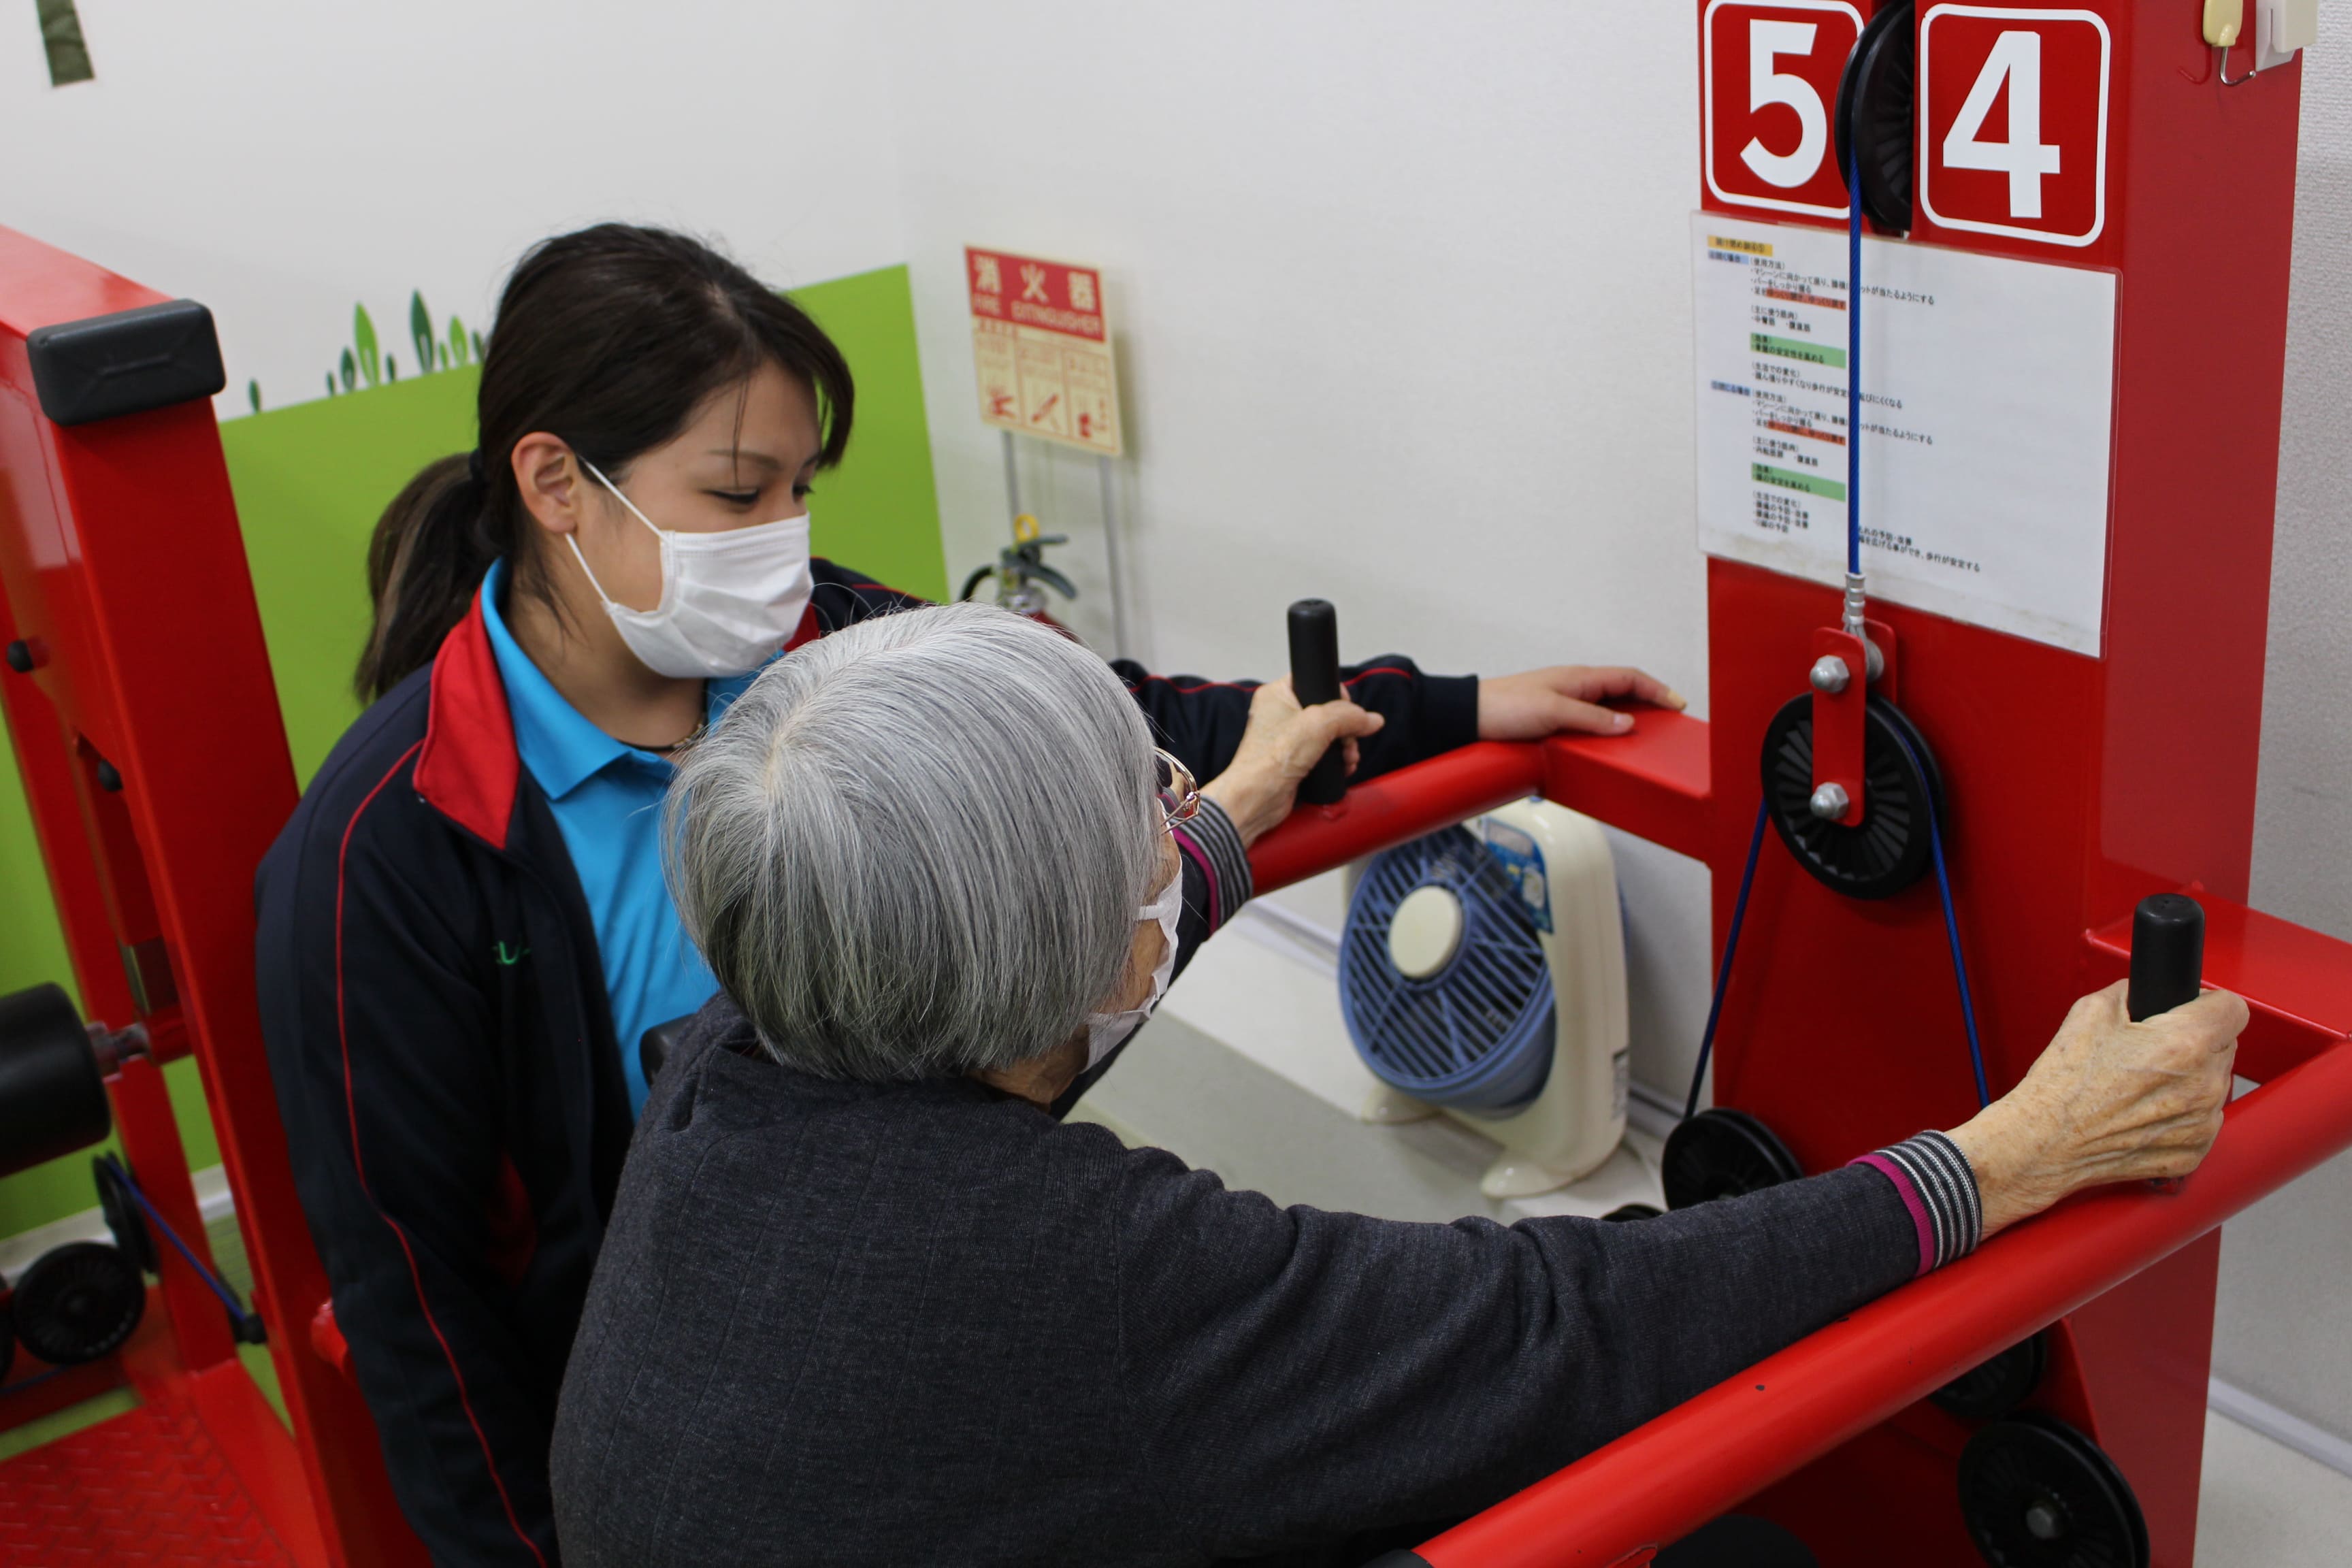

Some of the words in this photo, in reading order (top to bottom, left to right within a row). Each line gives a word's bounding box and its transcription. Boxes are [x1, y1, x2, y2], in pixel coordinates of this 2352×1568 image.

[1740, 18, 1828, 189] 5
[1942, 30, 2061, 219] 4
[973, 254, 1097, 312] 消火器
[974, 293, 1001, 314] FIRE
[1011, 301, 1101, 335] EXTINGUISHER
